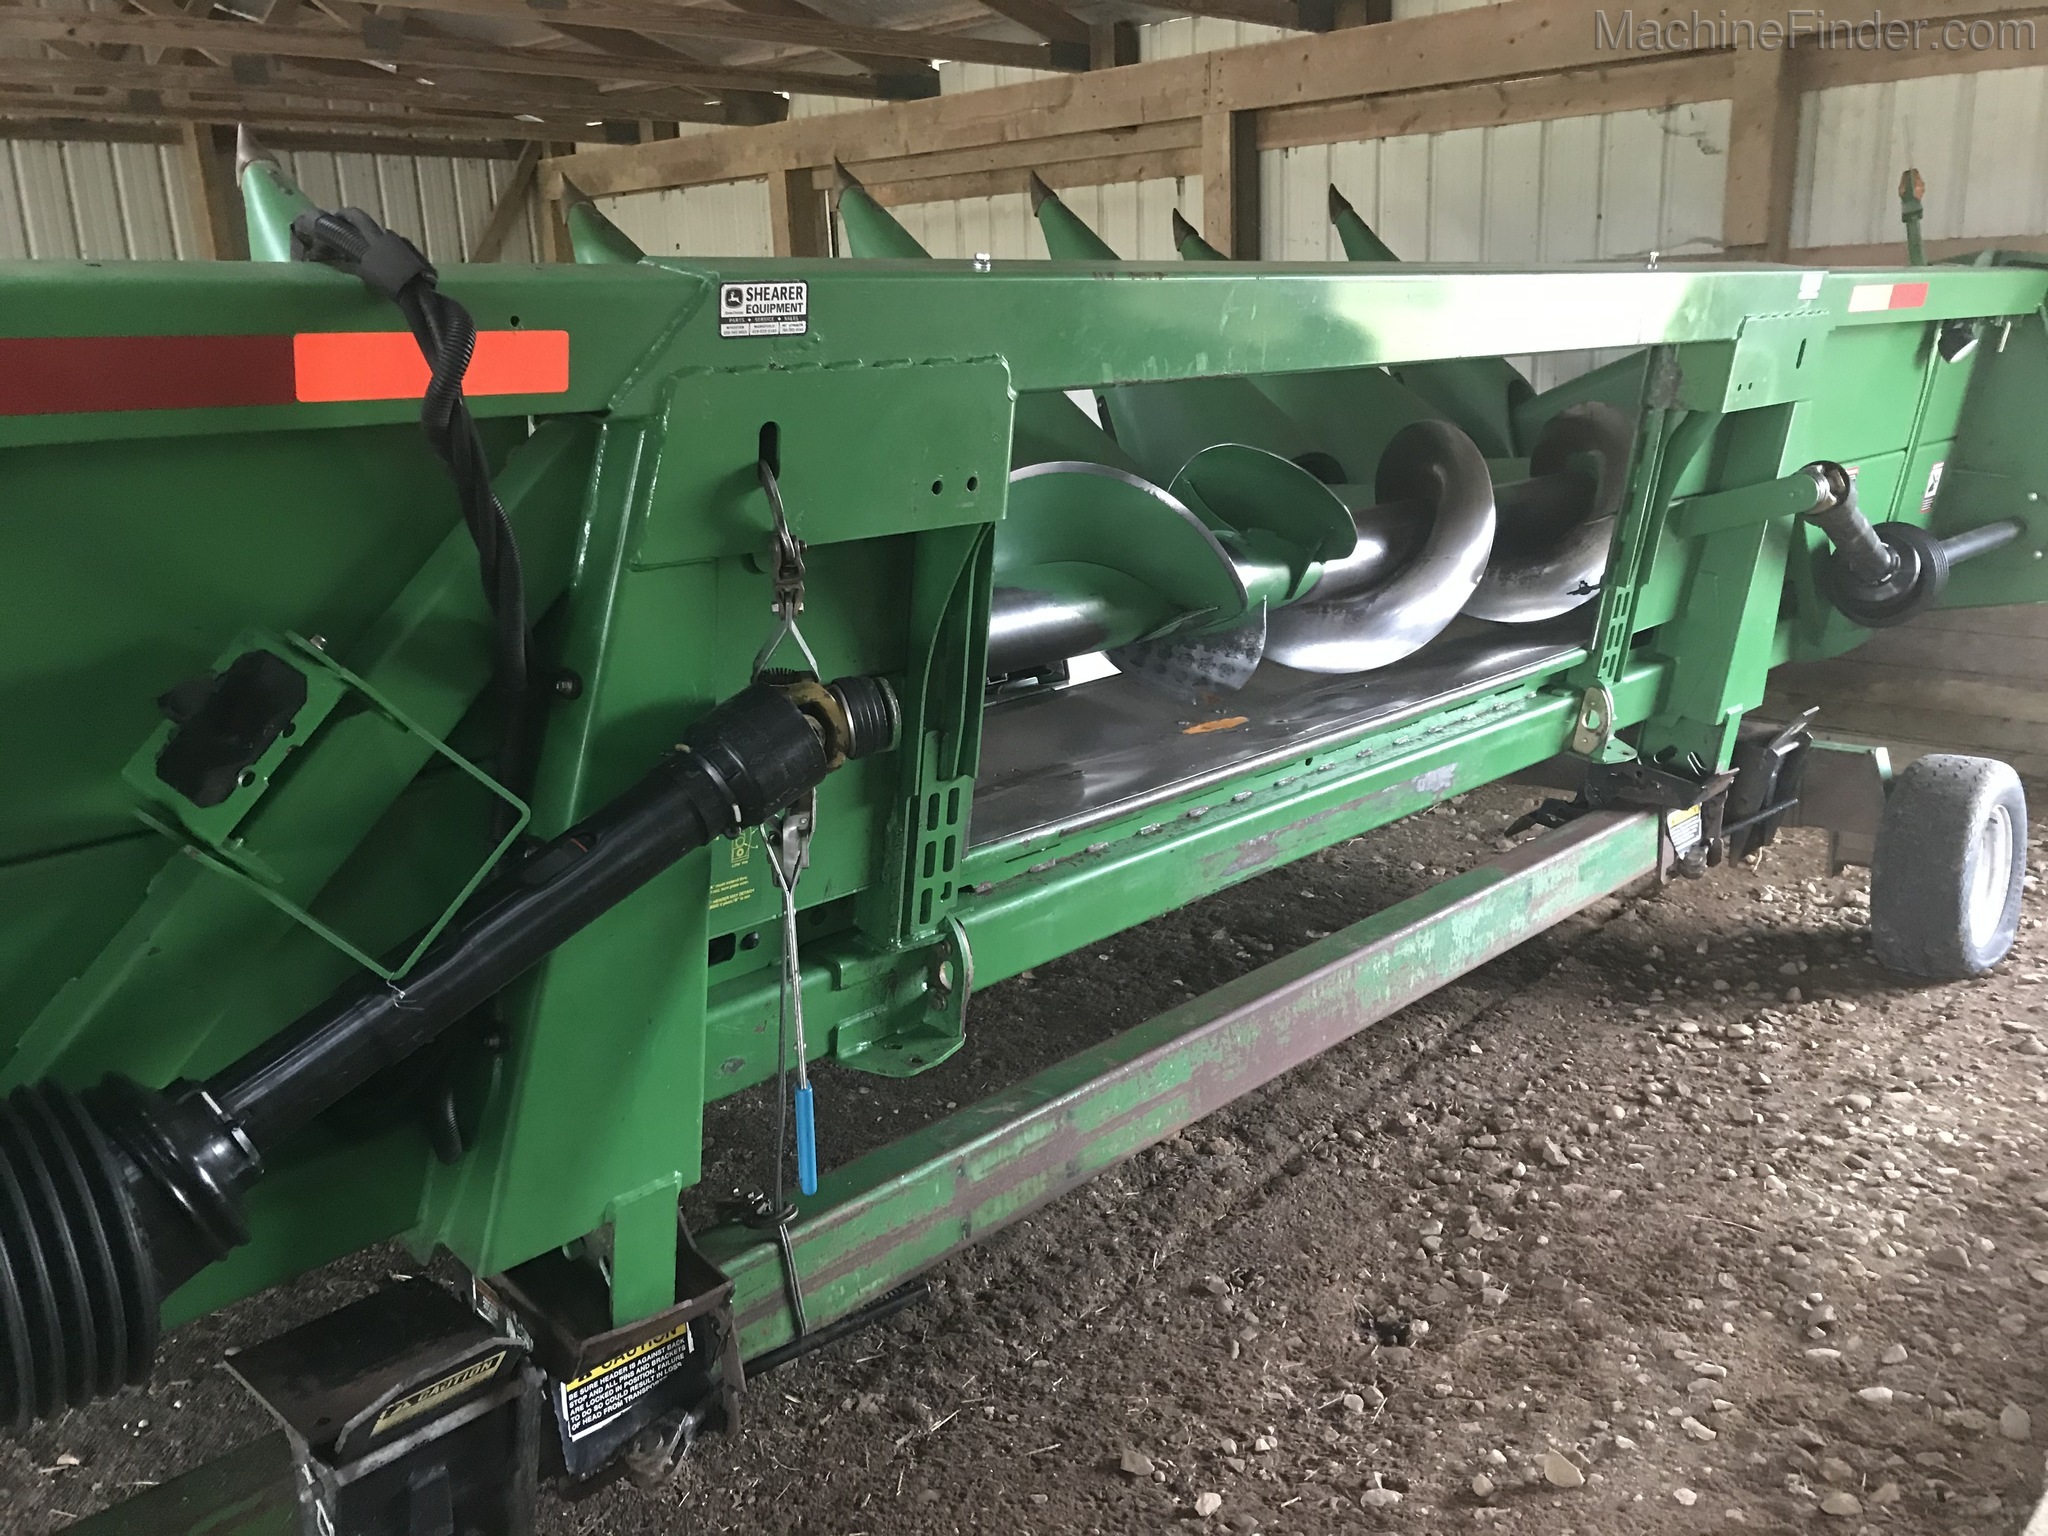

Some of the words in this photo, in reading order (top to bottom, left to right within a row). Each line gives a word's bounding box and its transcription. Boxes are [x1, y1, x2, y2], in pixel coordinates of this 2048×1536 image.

[746, 286, 804, 302] SHEARER
[746, 302, 804, 314] EQUIPMENT
[418, 1360, 492, 1402] CAUTION
[568, 1391, 578, 1401] BE
[580, 1381, 598, 1396] SURE
[600, 1366, 628, 1385] HEADER
[637, 1347, 666, 1366] AGAINST
[667, 1337, 685, 1350] BACK
[569, 1395, 587, 1408] STOP
[589, 1387, 603, 1398] AND
[605, 1380, 618, 1390] ALL
[619, 1371, 634, 1383] PINS
[636, 1363, 650, 1374] AND
[652, 1345, 686, 1366] BRACKETS
[570, 1404, 584, 1416] ARE
[586, 1390, 614, 1408] LOCKED
[624, 1368, 656, 1388] POSITION.
[658, 1353, 684, 1371] FAILURE
[571, 1414, 580, 1423] TO
[582, 1408, 592, 1418] DO
[594, 1403, 603, 1411] SO
[605, 1390, 628, 1405] COULD
[630, 1375, 655, 1393] RESULT
[572, 1421, 581, 1431] OF
[582, 1411, 602, 1425] HEAD
[603, 1400, 623, 1415] FROM
